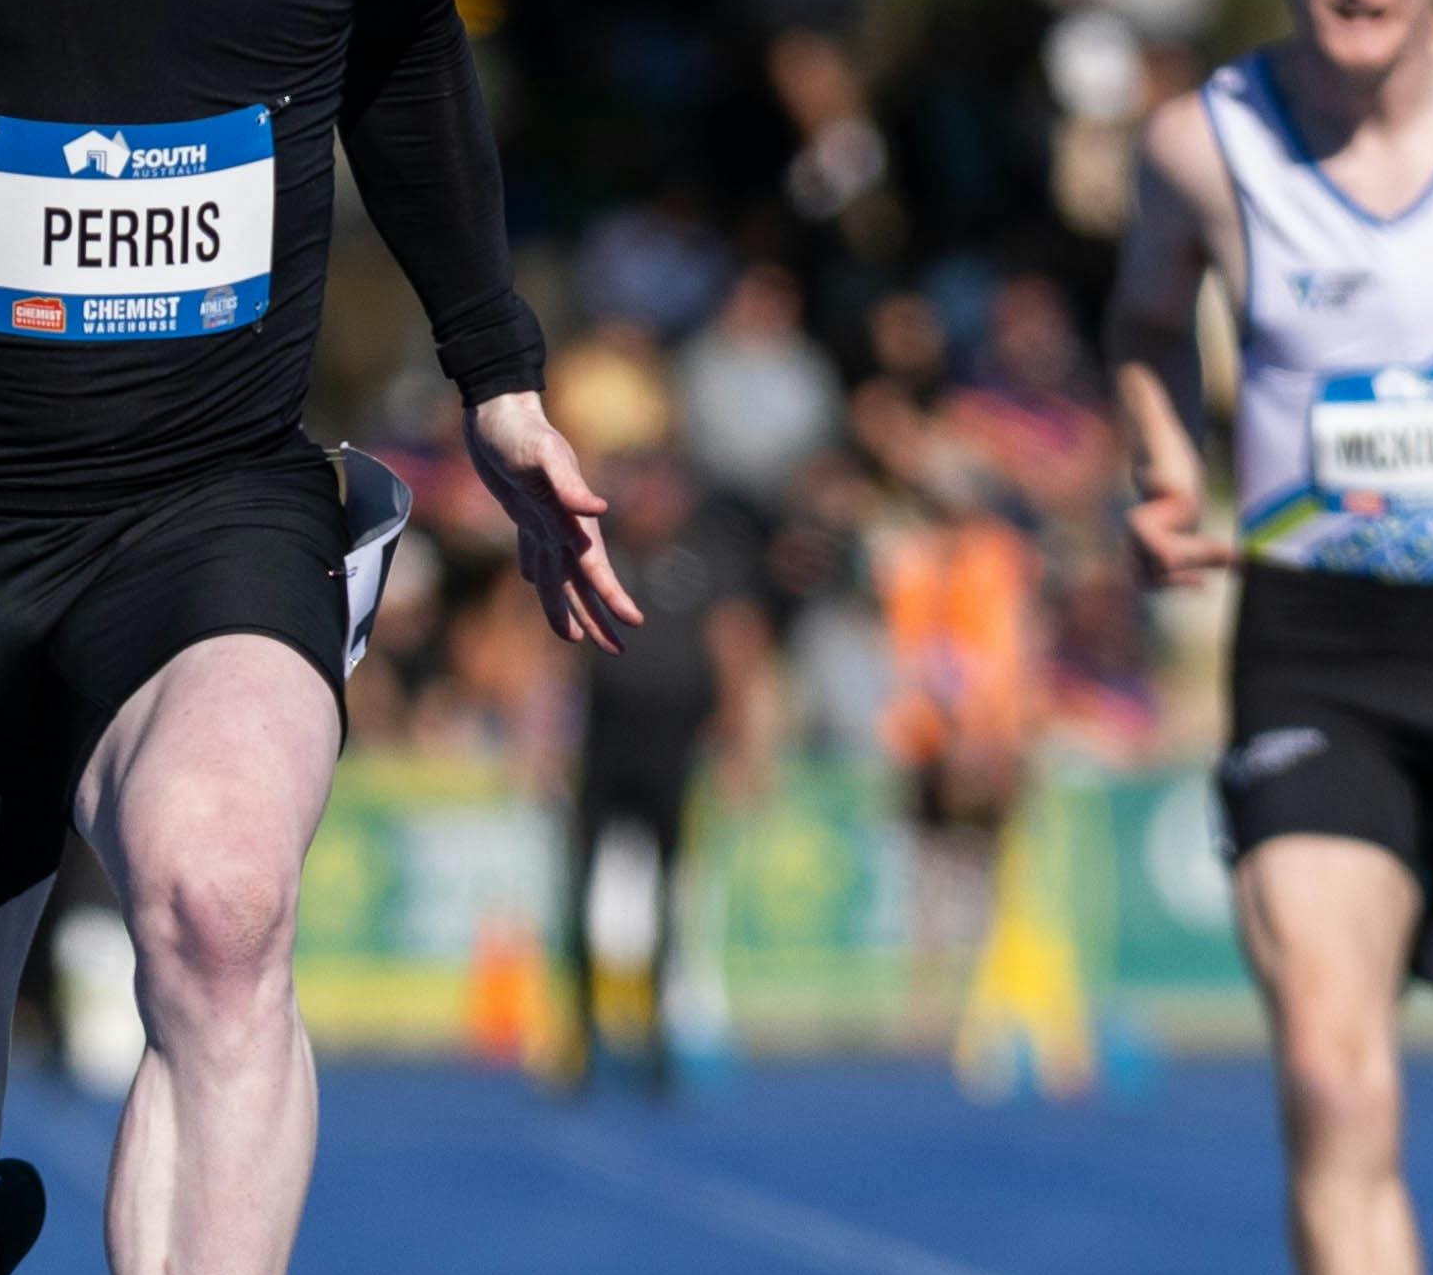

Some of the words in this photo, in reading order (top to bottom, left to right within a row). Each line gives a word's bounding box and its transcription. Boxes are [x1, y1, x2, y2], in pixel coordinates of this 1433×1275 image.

[132, 144, 207, 169] SOUTH
[133, 164, 207, 179] AUSTRALIA
[42, 201, 221, 268] PERRIS
[16, 306, 63, 321] CHEMIST
[83, 296, 181, 321] CHEMIST
[83, 320, 178, 334] WAREHOUSE
